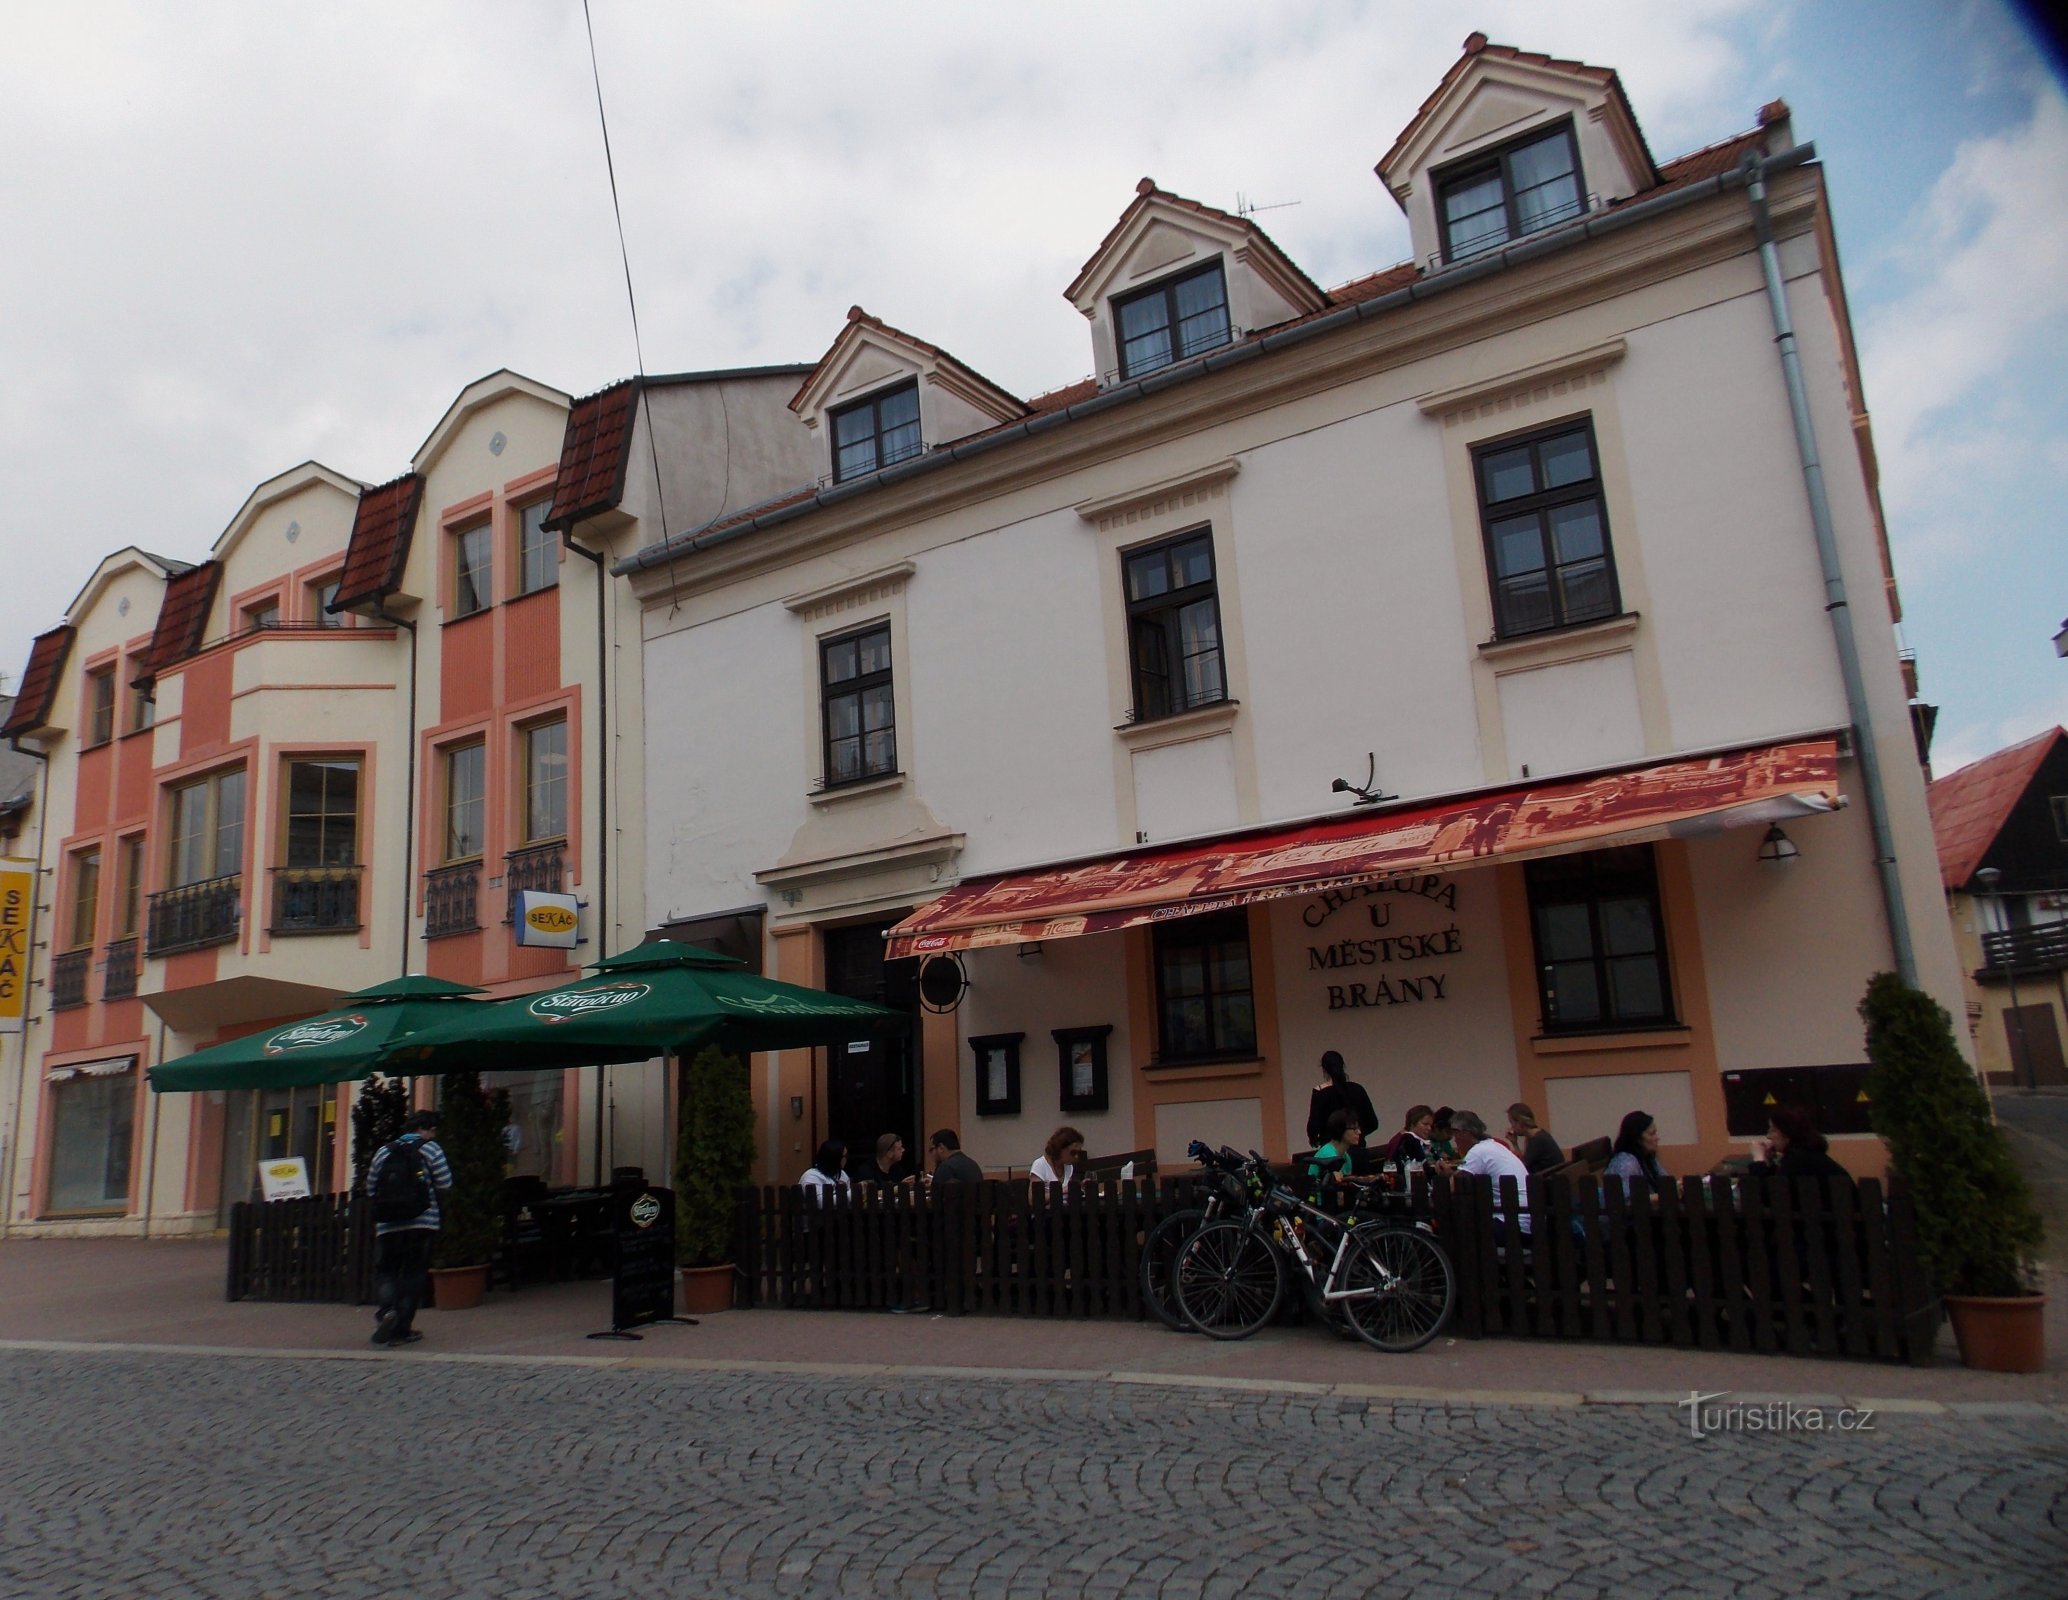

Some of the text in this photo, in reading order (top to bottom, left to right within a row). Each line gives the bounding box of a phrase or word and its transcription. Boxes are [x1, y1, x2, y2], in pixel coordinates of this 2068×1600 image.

[1367, 902, 1392, 928] U
[1307, 923, 1463, 970] MĚSTSKÉ
[1327, 974, 1446, 1010] BRÁNY
